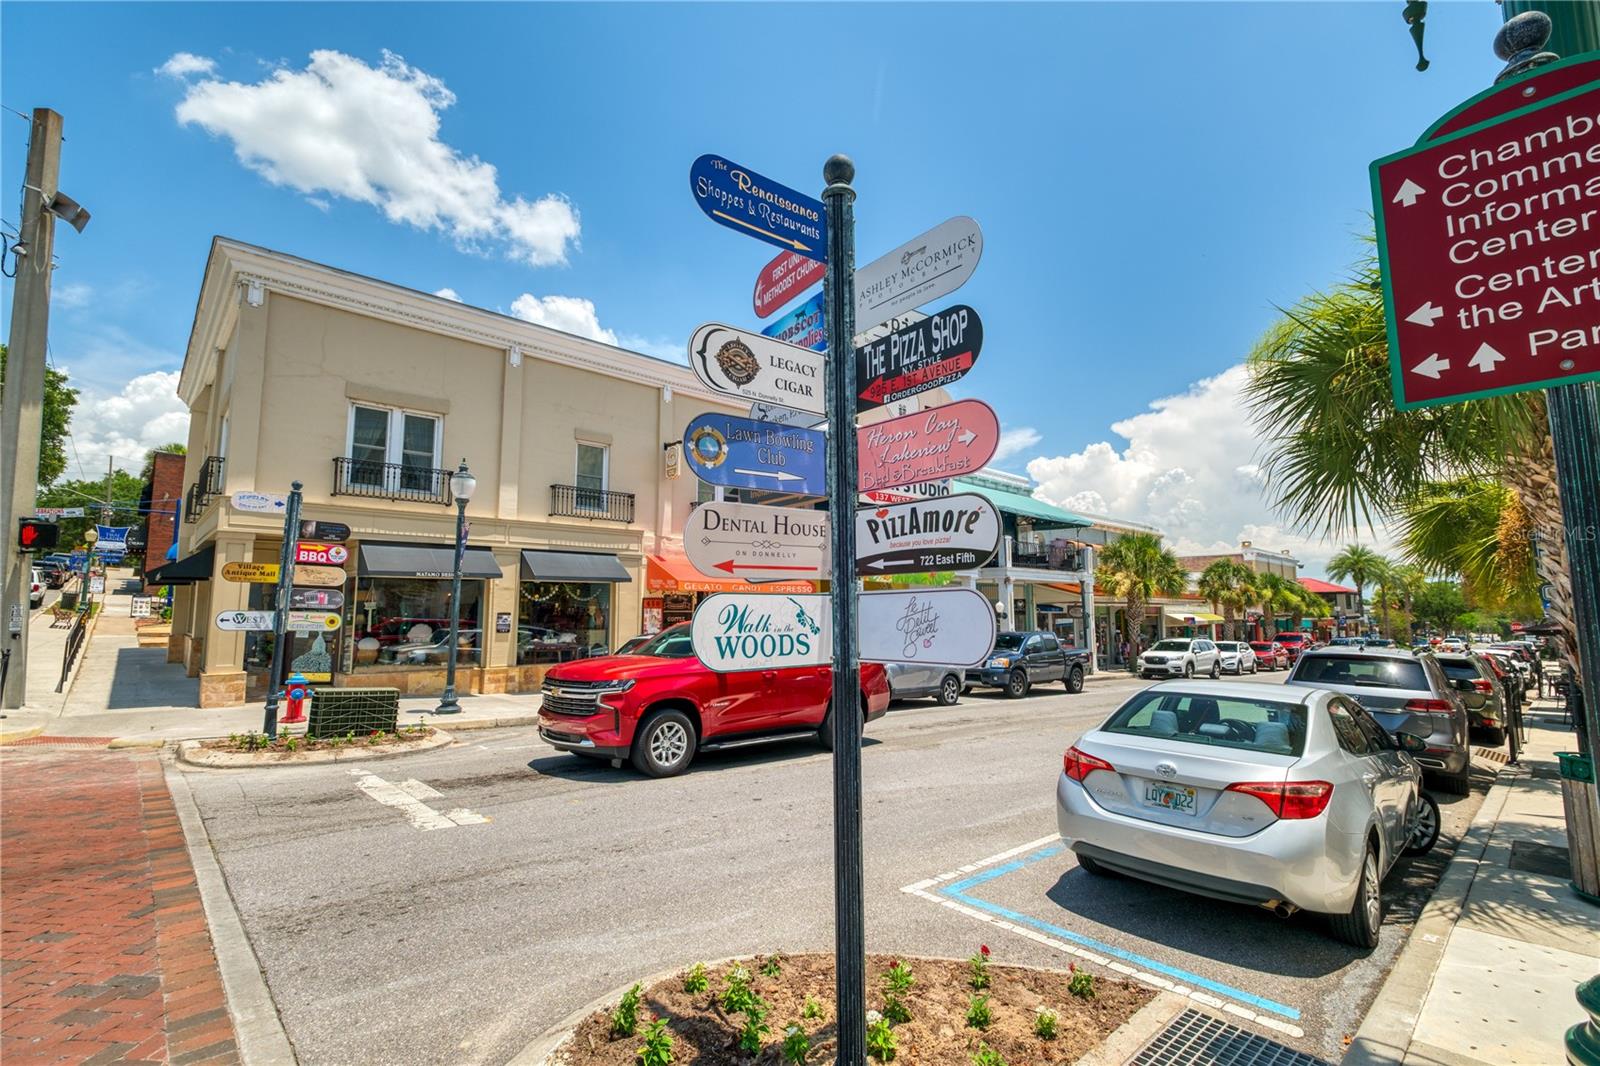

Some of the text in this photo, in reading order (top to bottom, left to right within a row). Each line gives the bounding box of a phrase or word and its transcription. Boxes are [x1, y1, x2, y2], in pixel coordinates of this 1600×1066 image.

[1438, 112, 1600, 180] Chamb
[711, 159, 819, 222] The Renaissance
[697, 176, 820, 240] Shoppes & Restaurants
[1449, 209, 1598, 265] Center
[772, 260, 788, 281] FIRST
[859, 233, 976, 302] ASHLEY McCORMICK
[1455, 248, 1600, 300] Center
[763, 272, 796, 305] METHODIST
[1457, 300, 1523, 330] the
[864, 344, 886, 380] THE
[891, 328, 926, 370] PIZZA
[931, 309, 968, 353] SHOP
[770, 355, 817, 378] LEGACY
[917, 353, 942, 370] STYLE
[775, 377, 813, 398] CIGAR
[870, 383, 888, 398] 925
[922, 357, 961, 381] AVENUE
[758, 392, 778, 402] Donnelly
[726, 423, 815, 453] Lawn Bowling
[867, 426, 916, 449] Heron
[757, 446, 786, 466] Club
[875, 493, 889, 501] 137
[703, 509, 826, 538] DENTAL HOUSE
[300, 551, 327, 562] BBQ
[752, 550, 796, 558] DONNELLY
[920, 552, 975, 566] 722 East Fifth
[684, 582, 722, 591] GELATO
[770, 584, 813, 593] ESPRESSO
[718, 603, 772, 635] Walk
[784, 623, 794, 633] the
[714, 633, 810, 660] WOODS
